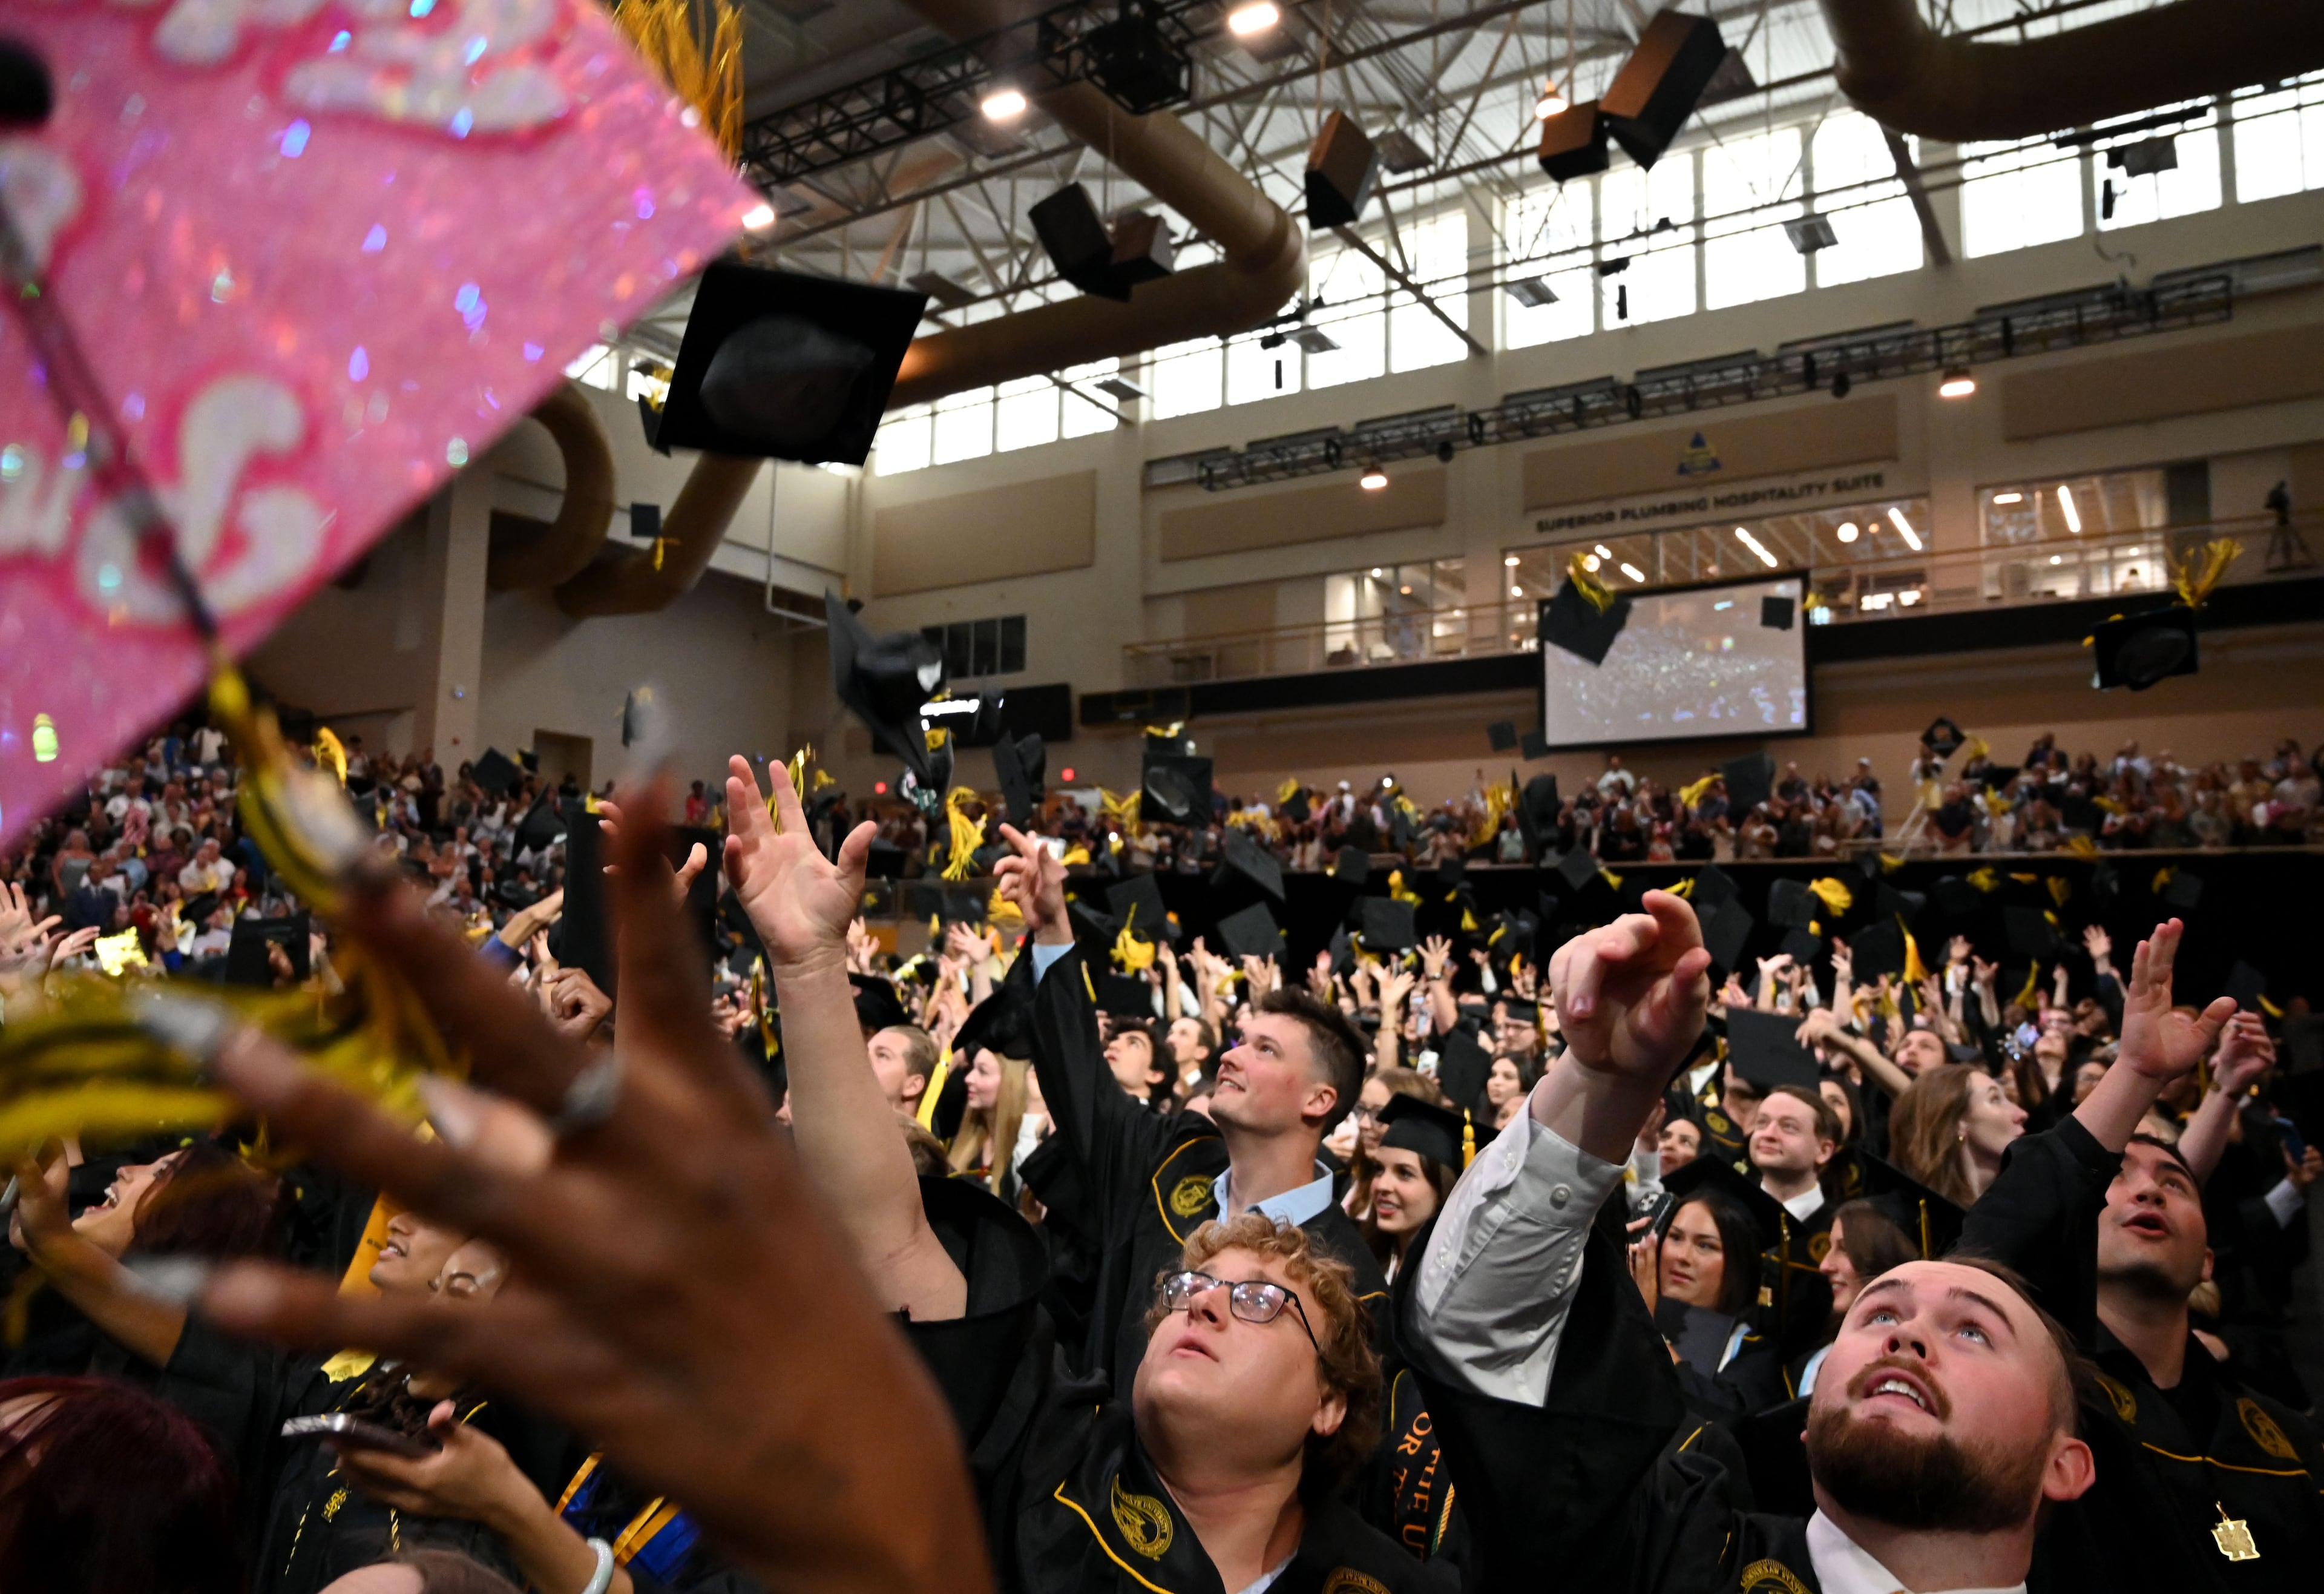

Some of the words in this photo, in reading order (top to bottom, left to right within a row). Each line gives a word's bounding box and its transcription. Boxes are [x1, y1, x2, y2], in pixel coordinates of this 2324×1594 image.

[1537, 510, 1616, 533] SUPERIOR
[1620, 496, 1708, 521] PLUMBING
[1713, 482, 1828, 507] HOSPITALITY
[1832, 472, 1883, 492] SUITE
